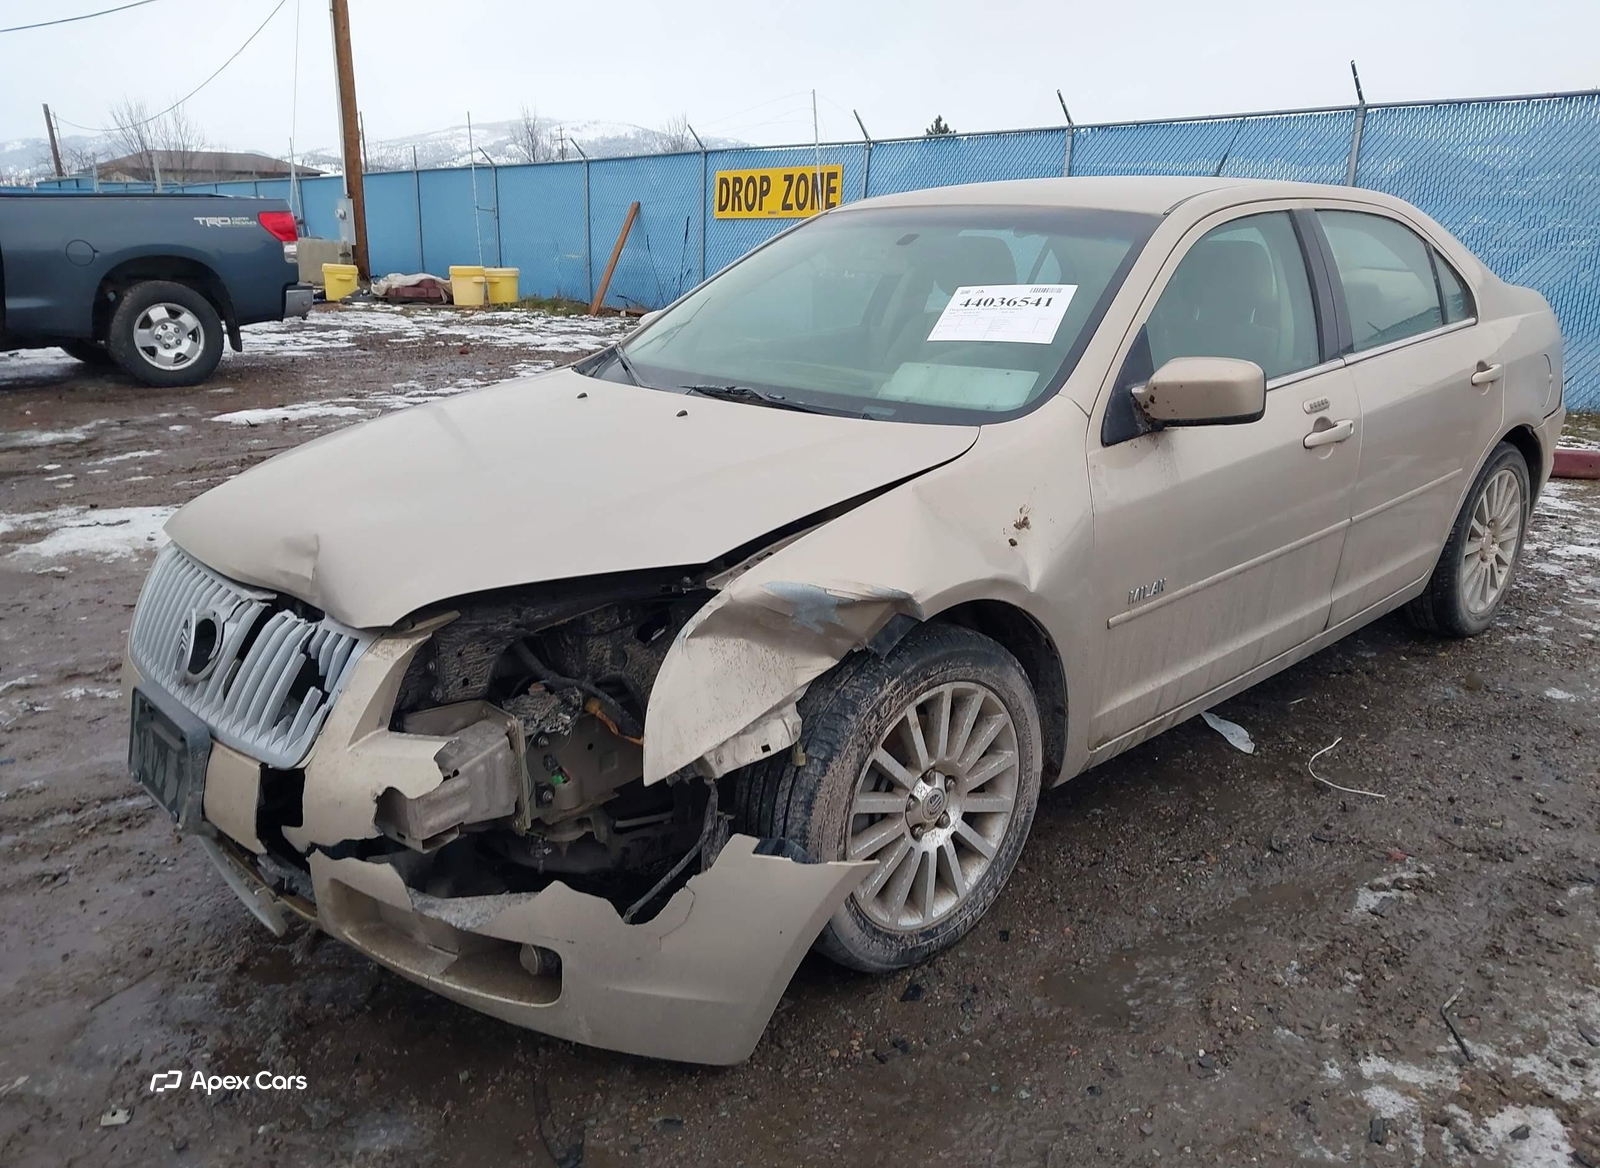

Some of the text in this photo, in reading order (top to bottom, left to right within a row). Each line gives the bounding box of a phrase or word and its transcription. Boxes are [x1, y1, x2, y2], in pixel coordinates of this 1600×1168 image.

[718, 172, 838, 212] DROP ZONE
[194, 217, 231, 227] TRD
[960, 297, 1053, 308] 44036541
[1128, 578, 1167, 605] MILAN
